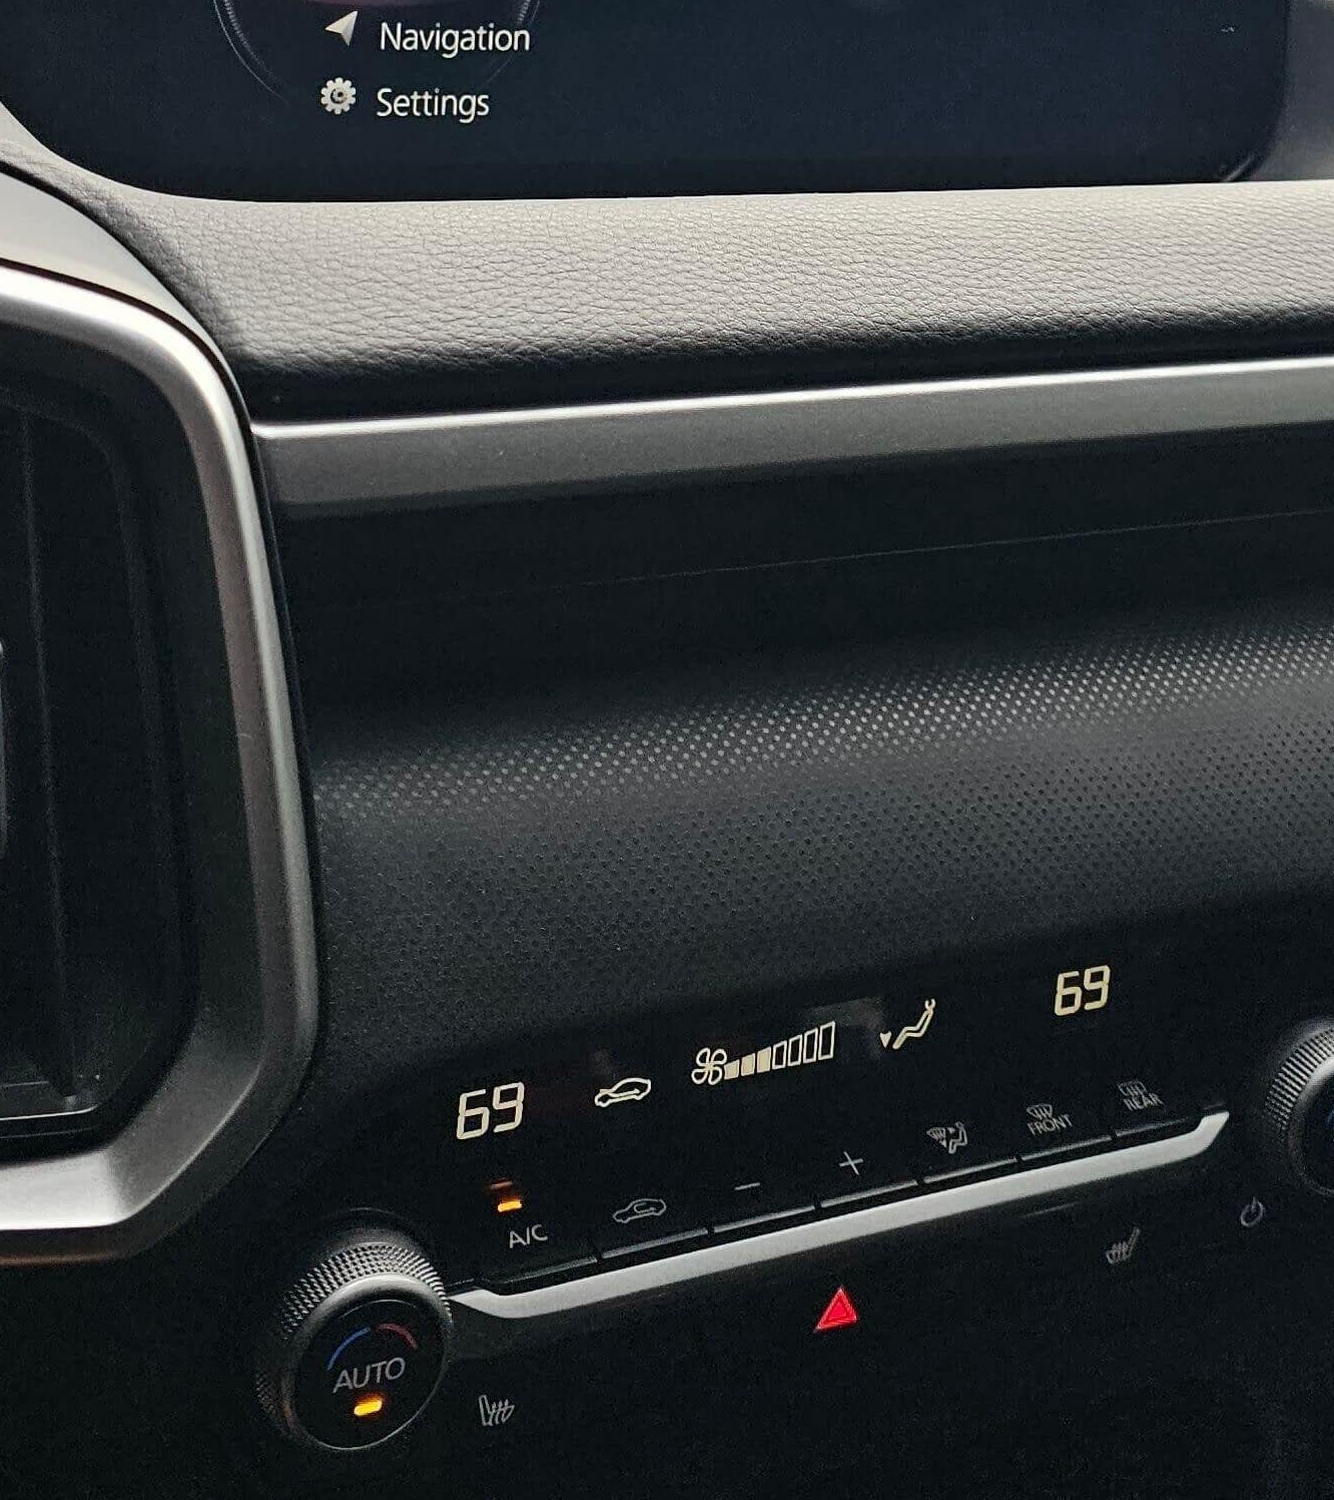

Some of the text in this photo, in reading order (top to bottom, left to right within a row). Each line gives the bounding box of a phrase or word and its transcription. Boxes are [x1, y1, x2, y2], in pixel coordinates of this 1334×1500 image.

[379, 21, 531, 59] Navigation
[376, 87, 490, 124] Settings
[1053, 964, 1111, 1017] 69
[455, 1081, 526, 1140] 69
[1121, 1091, 1165, 1113] REAR
[1026, 1113, 1075, 1137] FRONT
[508, 1223, 549, 1249] A/C
[331, 1356, 407, 1394] AUTO
